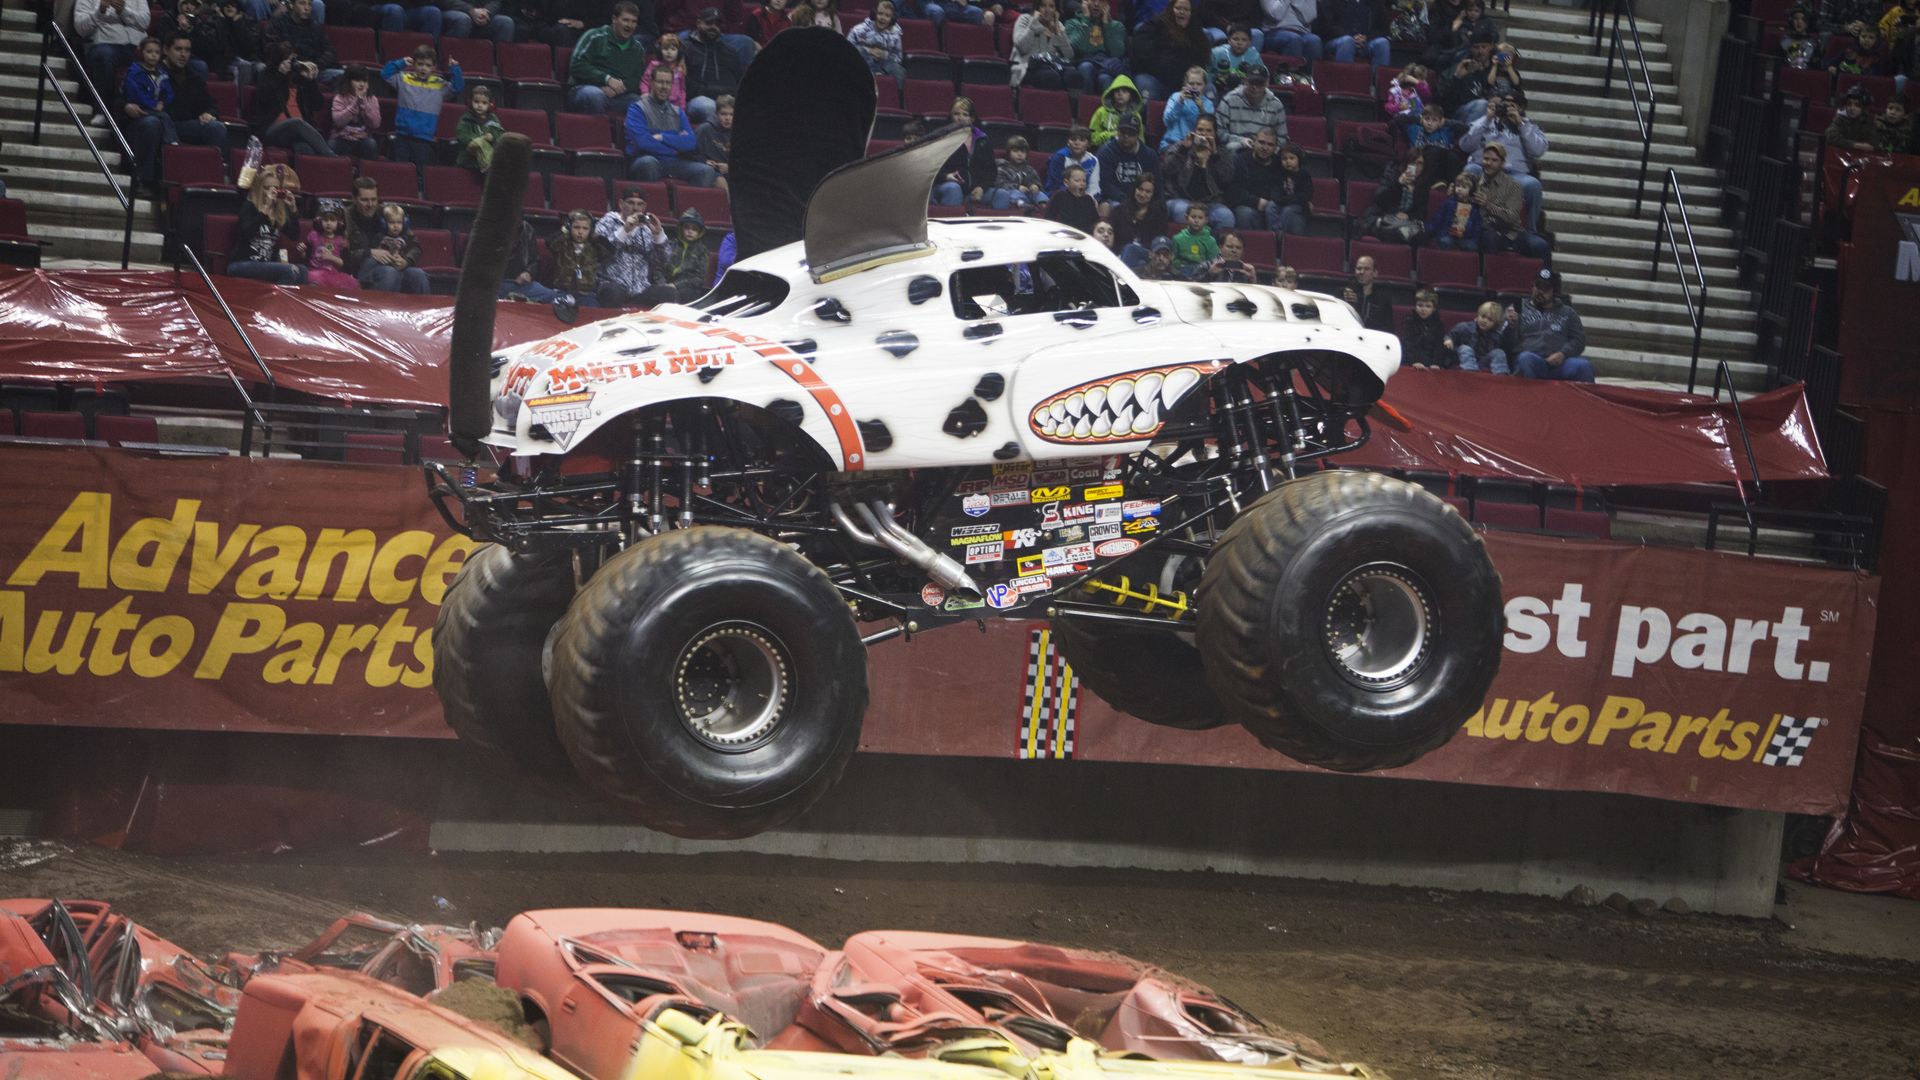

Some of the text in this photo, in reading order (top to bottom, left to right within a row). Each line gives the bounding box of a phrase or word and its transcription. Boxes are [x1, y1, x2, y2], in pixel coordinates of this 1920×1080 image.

[531, 408, 592, 425] MONSTER
[547, 420, 579, 433] JAM
[1070, 469, 1100, 479] Coan
[993, 491, 1026, 503] DERALE
[1063, 504, 1094, 518] KING
[1089, 524, 1120, 537] CROWER
[951, 533, 1002, 546] MAGNAFLOW
[6, 491, 473, 606] Advance
[969, 544, 1001, 556] OPTIMA
[1046, 564, 1075, 576] HAWK
[1011, 575, 1045, 586] LINCOLN
[987, 584, 1008, 607] VP
[194, 602, 435, 689] Parts
[1611, 604, 1831, 683] part.
[1820, 609, 1840, 623] SM
